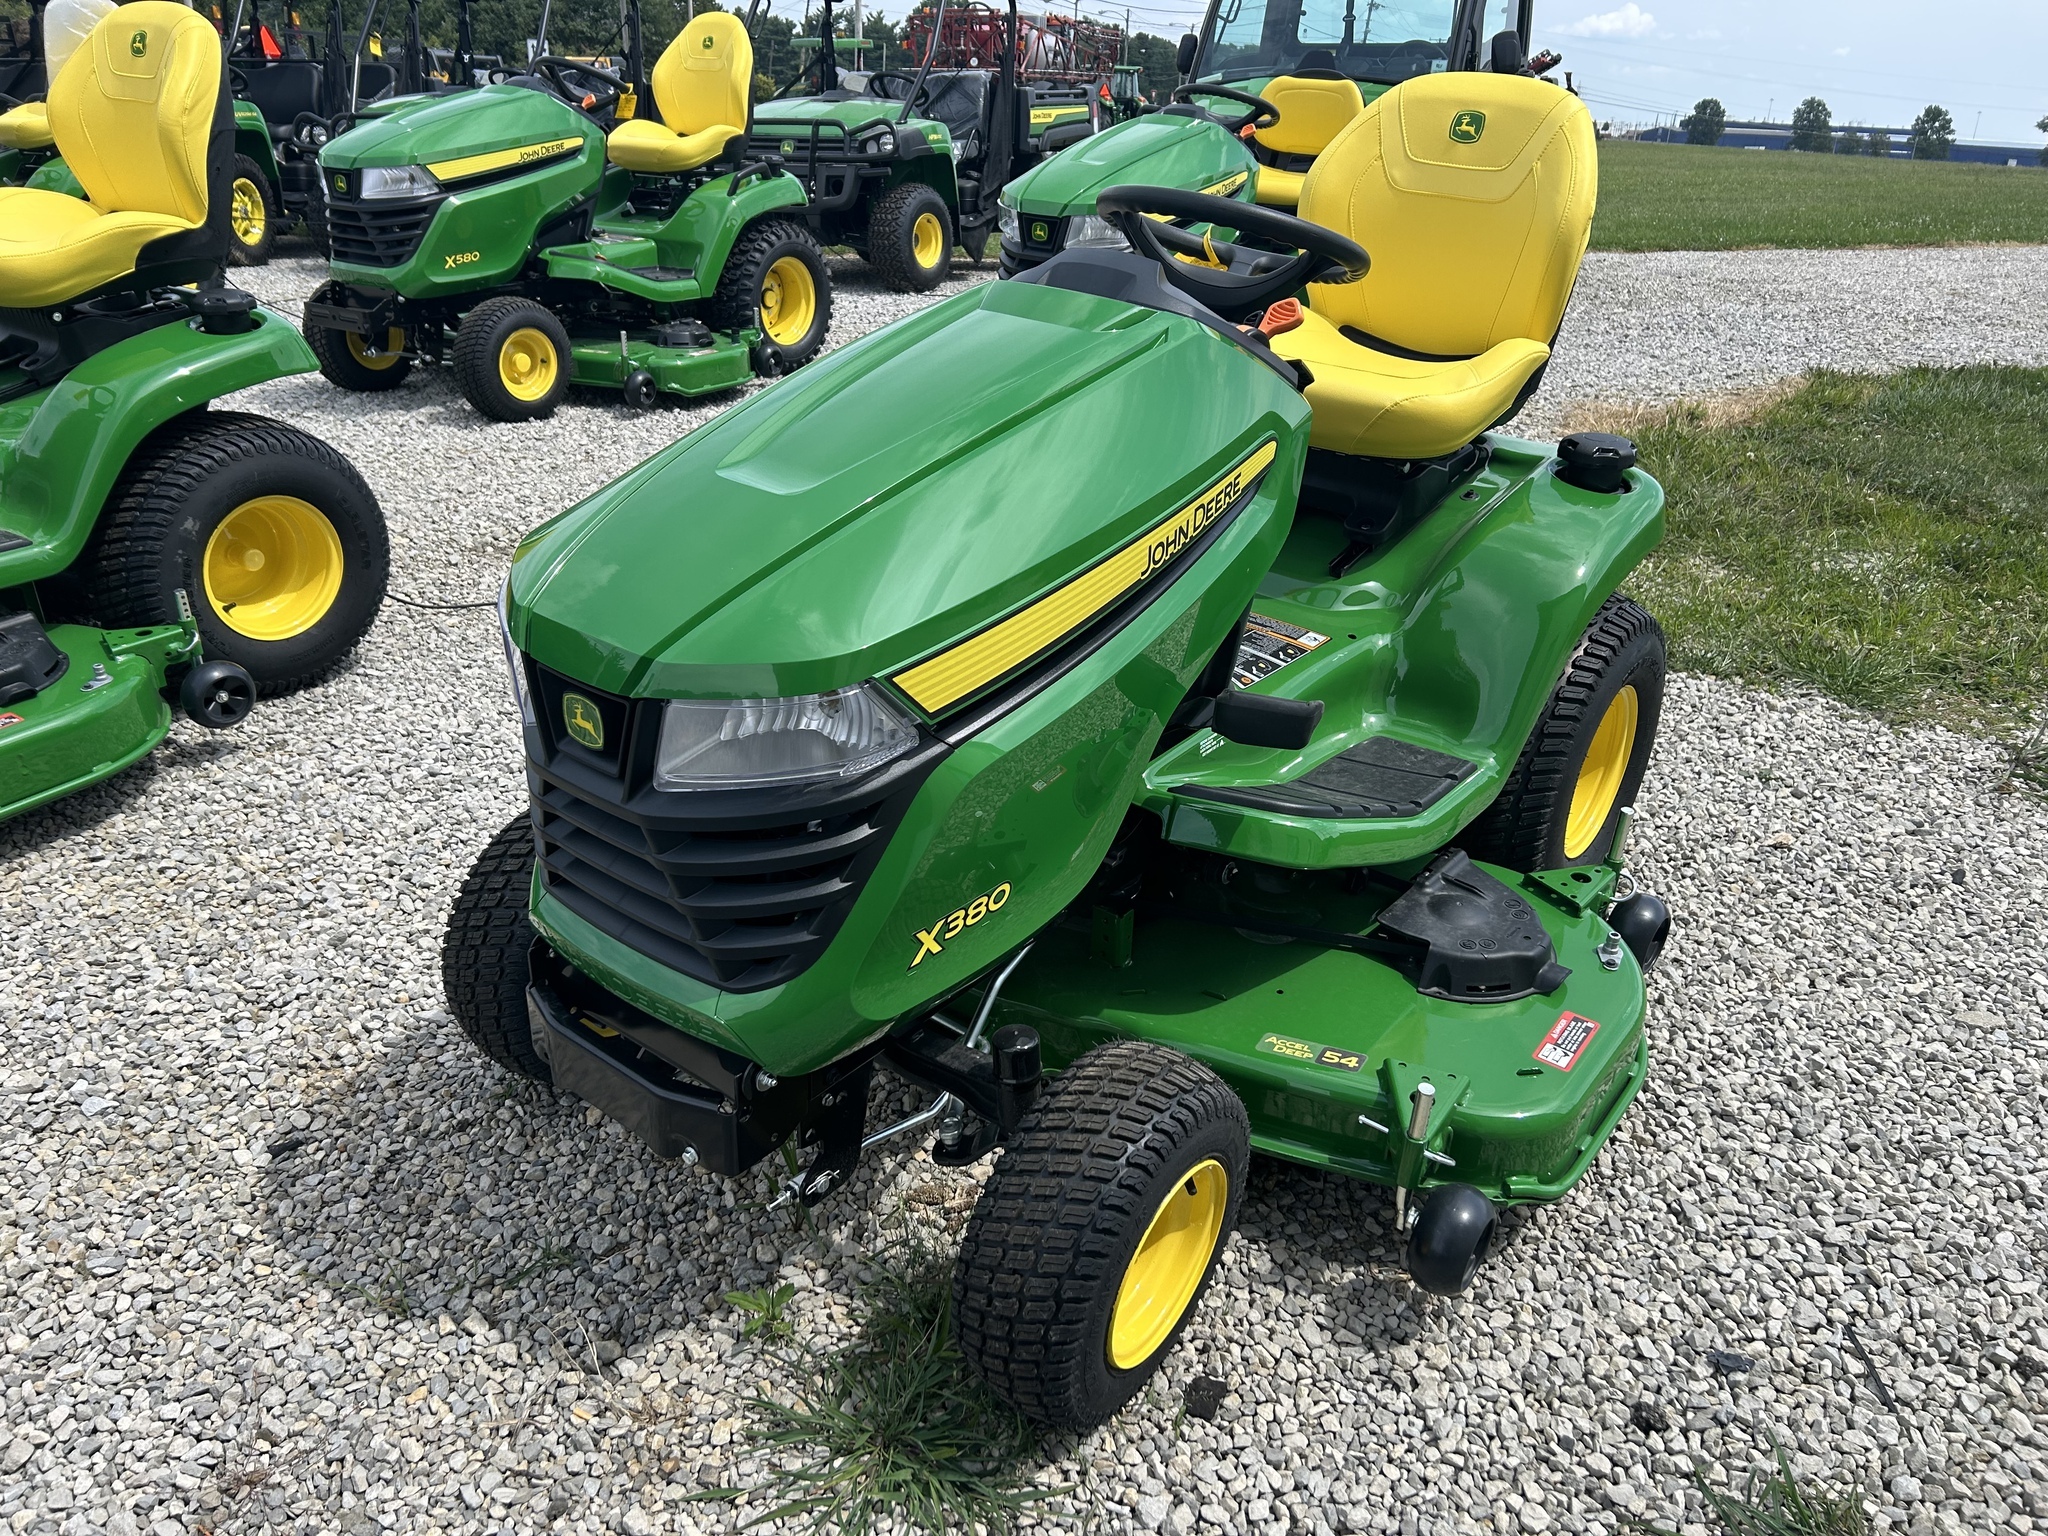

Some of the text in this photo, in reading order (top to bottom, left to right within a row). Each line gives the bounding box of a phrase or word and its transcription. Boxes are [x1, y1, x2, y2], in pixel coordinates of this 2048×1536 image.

[518, 142, 565, 163] JOHN DEERE
[444, 251, 480, 269] X580
[1140, 472, 1242, 579] JOHN DEERE
[907, 881, 1013, 970] X380
[1265, 1036, 1312, 1052] ACCEL
[1272, 1045, 1314, 1059] DEEP
[1321, 1050, 1360, 1069] 54
